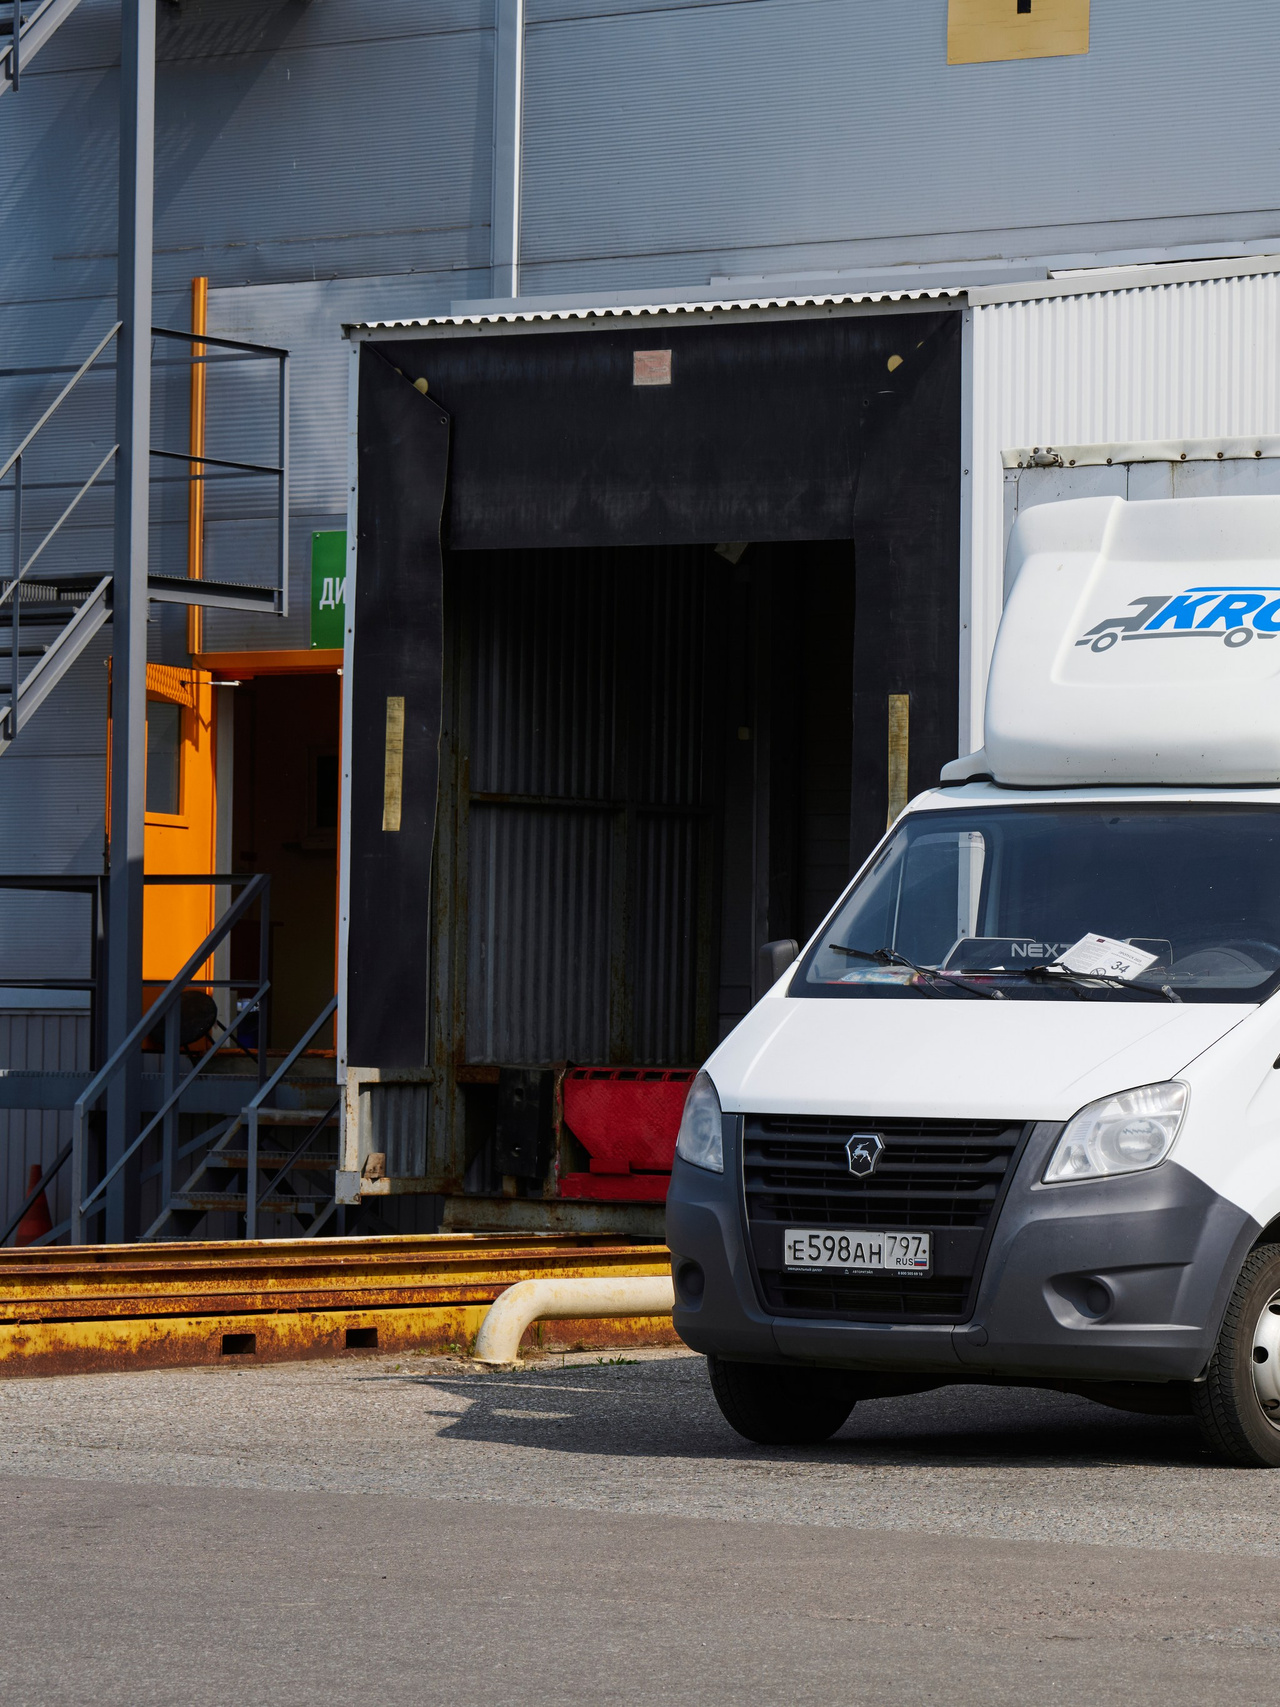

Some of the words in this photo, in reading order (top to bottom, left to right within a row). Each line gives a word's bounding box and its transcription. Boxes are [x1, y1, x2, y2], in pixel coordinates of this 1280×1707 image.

[1111, 961, 1131, 974] 34
[887, 1236, 922, 1257] 797
[896, 1257, 914, 1266] RUS
